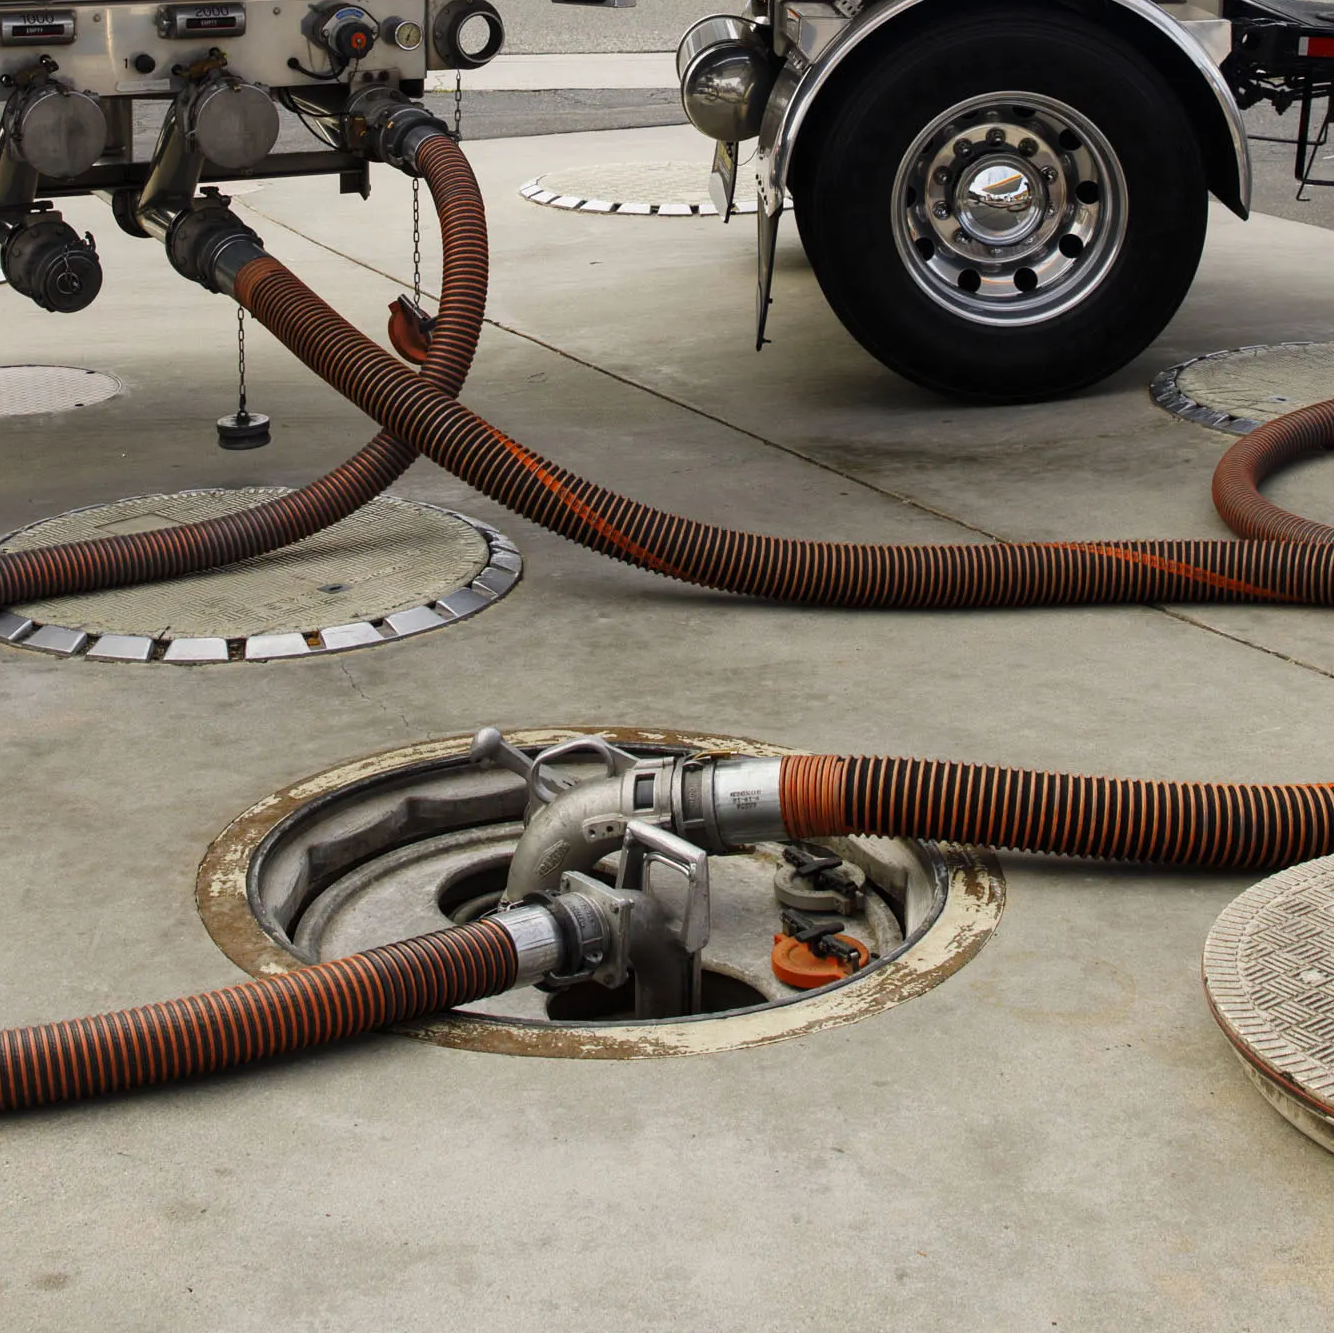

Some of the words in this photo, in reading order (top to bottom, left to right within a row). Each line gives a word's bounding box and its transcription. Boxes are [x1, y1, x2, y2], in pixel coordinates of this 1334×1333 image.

[195, 7, 229, 18] 2000
[21, 13, 54, 24] 1000
[123, 58, 128, 69] 1
